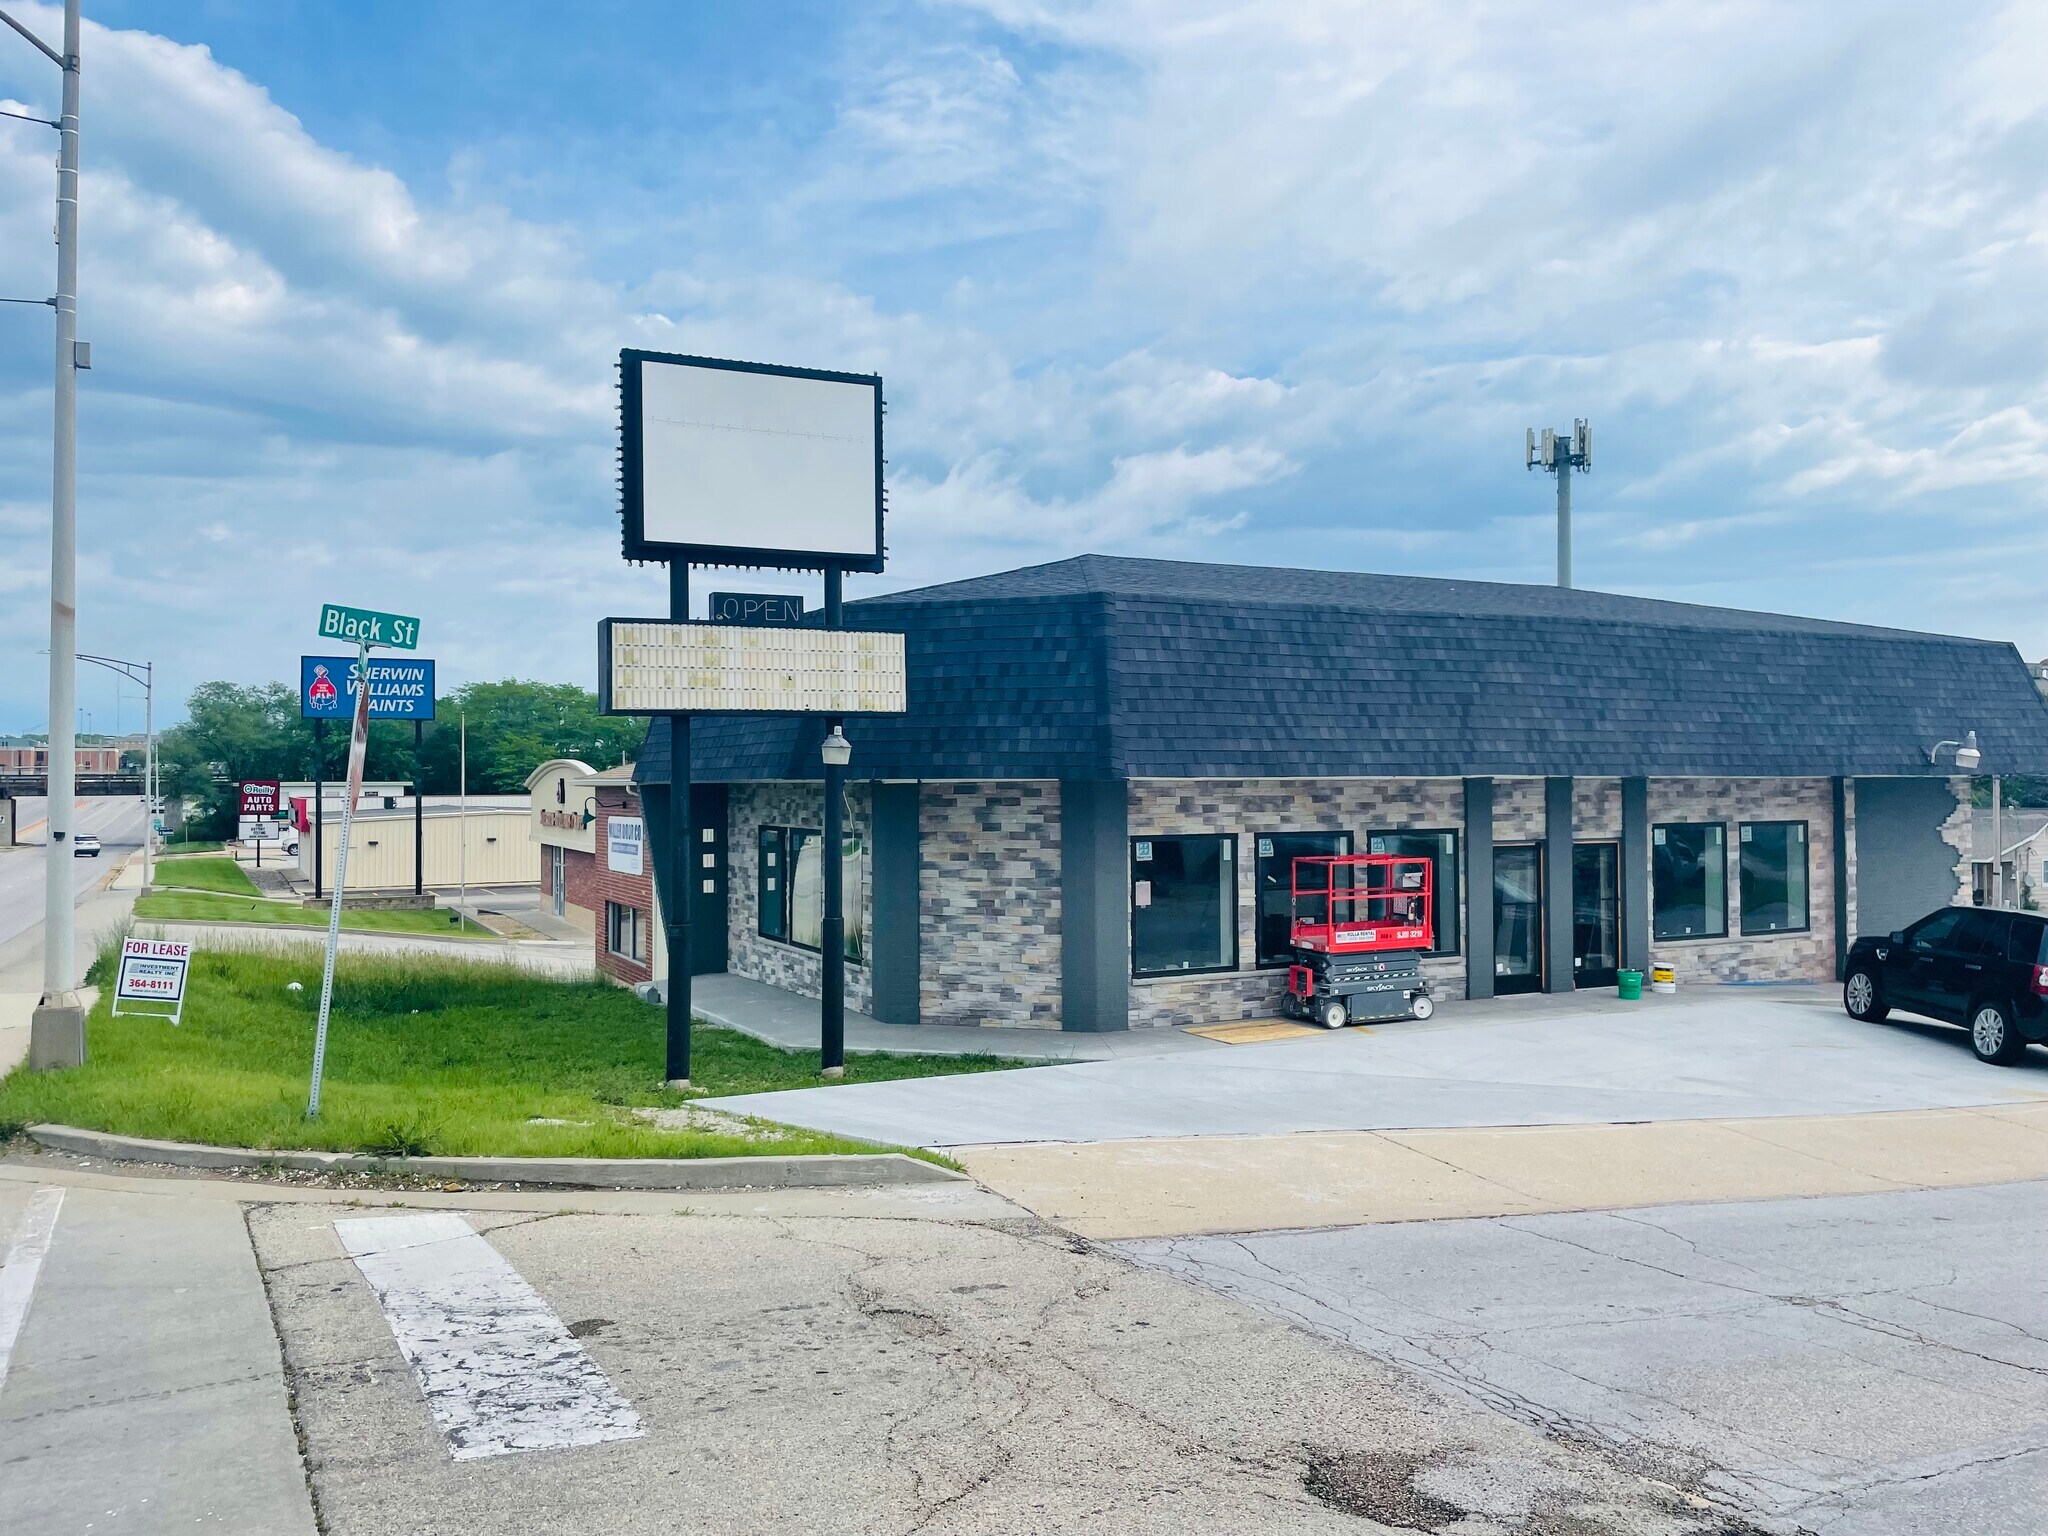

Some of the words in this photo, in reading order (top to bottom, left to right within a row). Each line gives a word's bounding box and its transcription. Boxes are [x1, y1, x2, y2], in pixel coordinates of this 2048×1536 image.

[723, 597, 799, 622] OPEN
[324, 608, 382, 641] Black
[390, 619, 415, 646] St
[346, 680, 426, 697] WLLIAMS
[366, 698, 415, 713] AINTS
[244, 784, 275, 795] O'Reilly
[247, 796, 272, 804] AUTO
[125, 941, 149, 954] FOR
[152, 943, 189, 957] LEASE
[129, 979, 173, 989] 364-8111
[1366, 983, 1395, 992] SKYJACK
